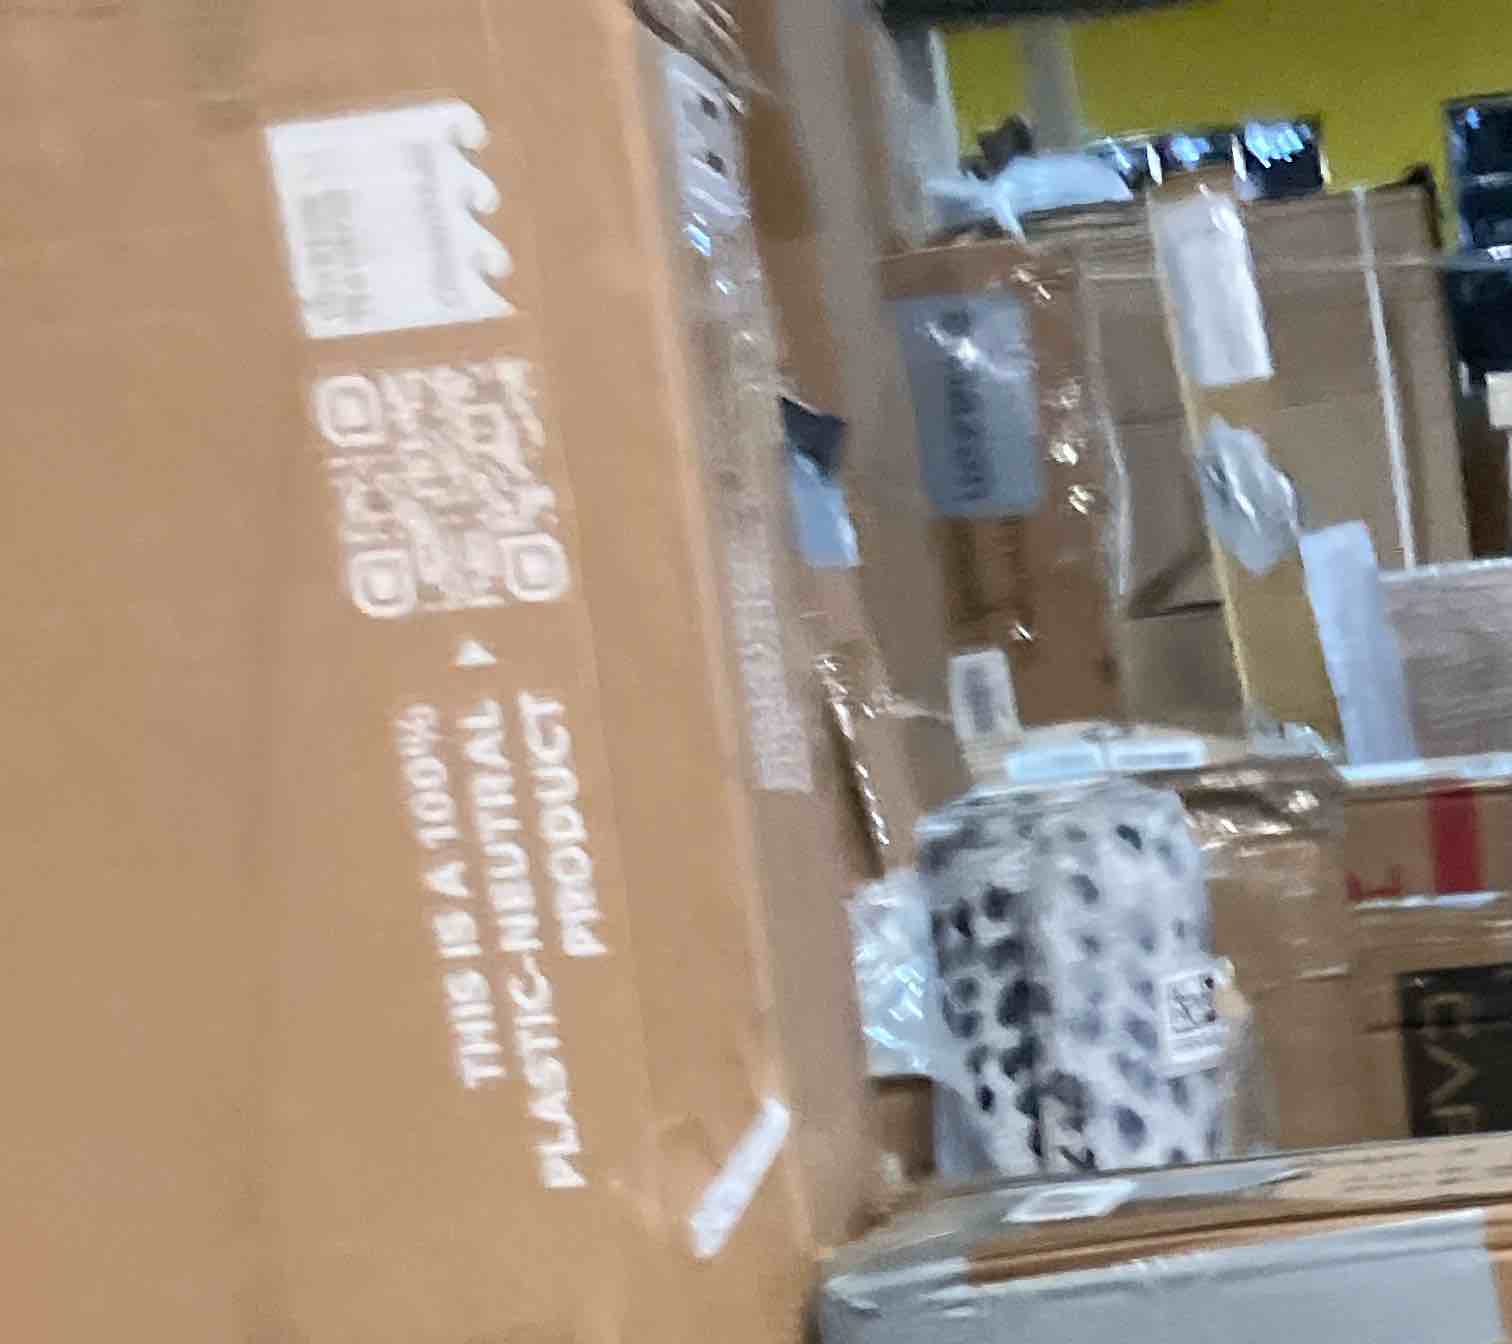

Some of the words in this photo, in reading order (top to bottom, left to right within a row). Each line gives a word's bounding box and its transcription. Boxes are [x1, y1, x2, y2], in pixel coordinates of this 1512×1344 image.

[423, 860, 473, 899] A
[431, 910, 482, 960] IS
[446, 967, 506, 1089] THIS
